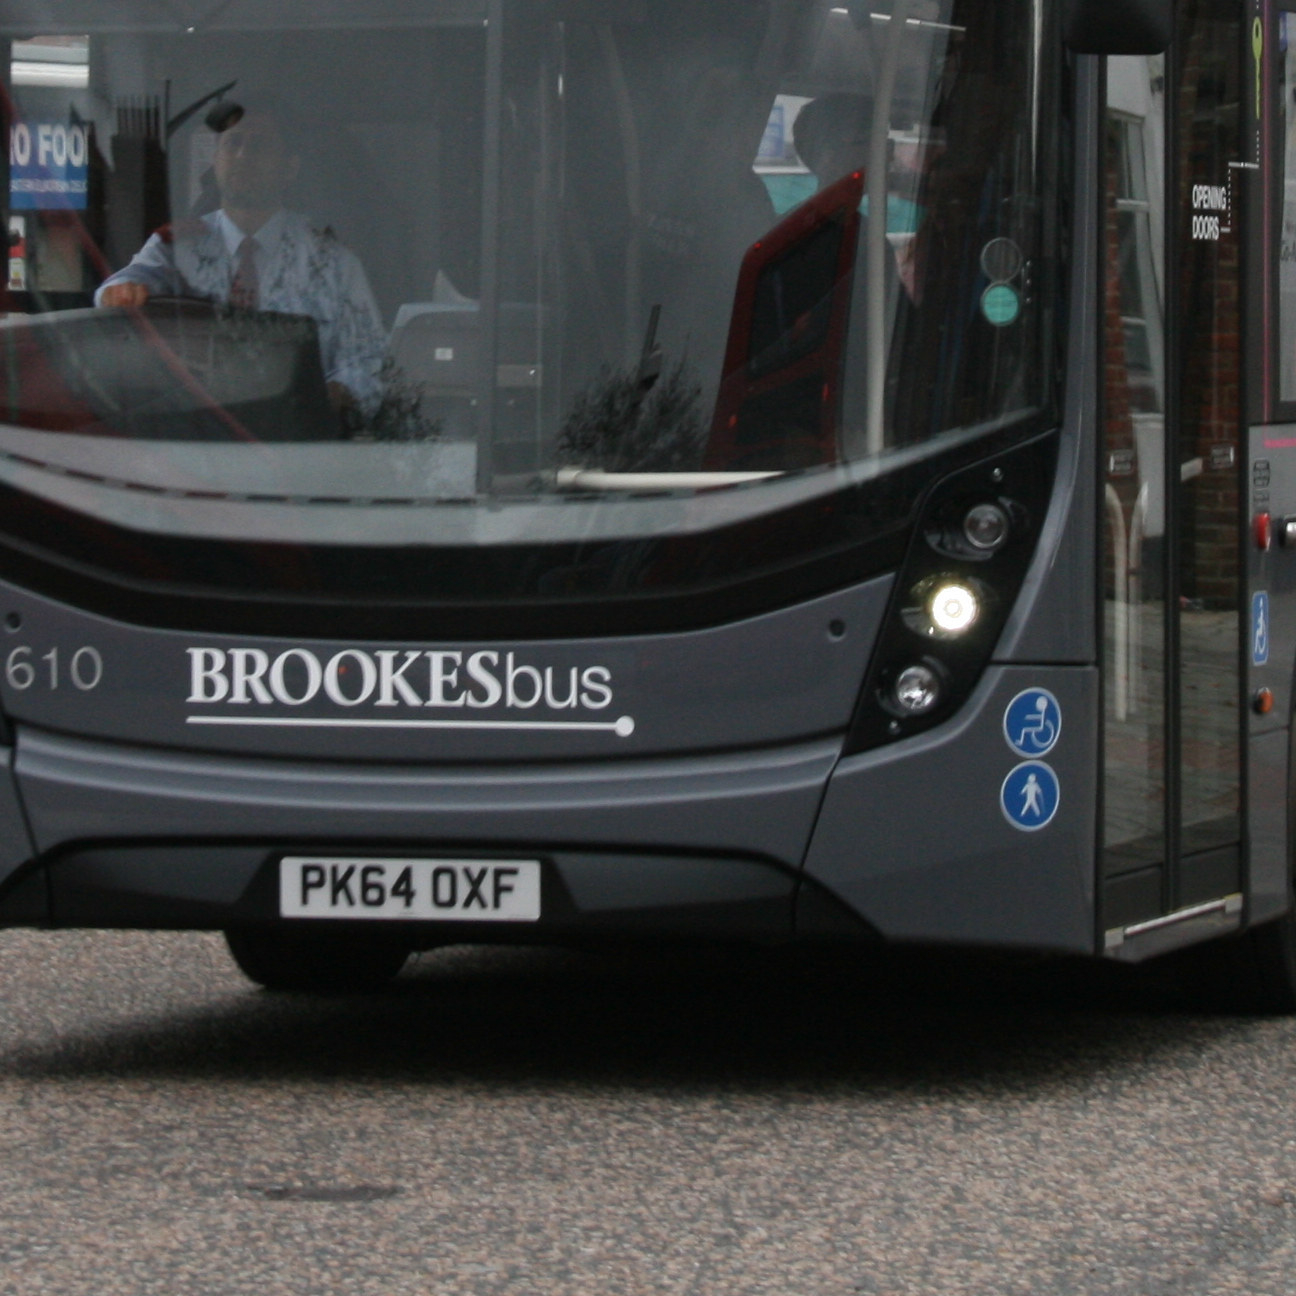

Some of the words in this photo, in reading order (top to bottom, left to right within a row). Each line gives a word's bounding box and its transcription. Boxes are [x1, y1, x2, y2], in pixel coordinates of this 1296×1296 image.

[38, 122, 89, 167] FOO
[1192, 184, 1226, 211] OPENING
[1192, 215, 1219, 241] DOORS
[5, 645, 104, 691] 610
[186, 646, 614, 710] BROOKESbus
[300, 865, 417, 909] PK64
[432, 866, 521, 909] OXF
